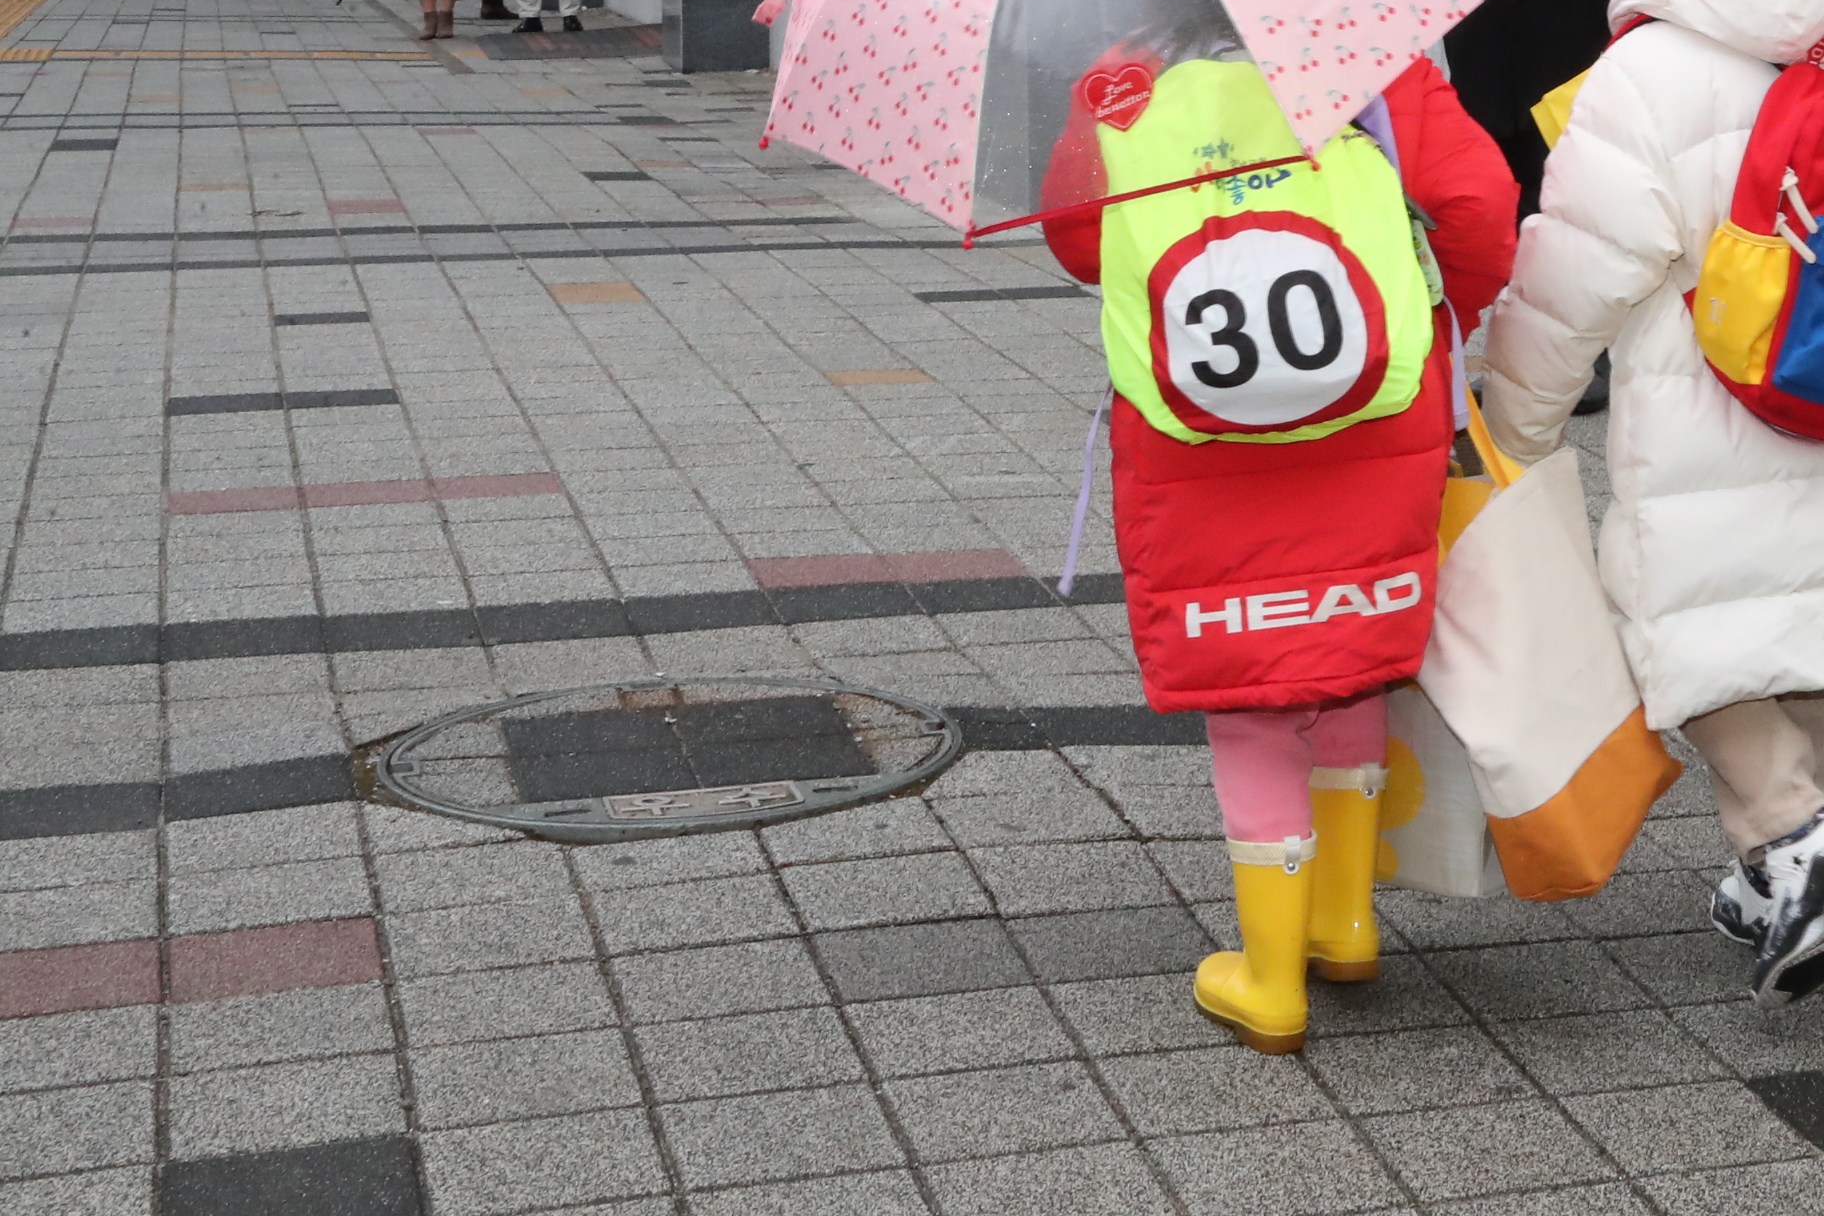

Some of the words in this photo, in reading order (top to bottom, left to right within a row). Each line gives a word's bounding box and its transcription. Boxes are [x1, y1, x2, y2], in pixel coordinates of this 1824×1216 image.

[1101, 82, 1134, 106] Love
[1185, 269, 1344, 389] 30
[1185, 571, 1422, 638] HEAD
[621, 787, 787, 817] 우수
